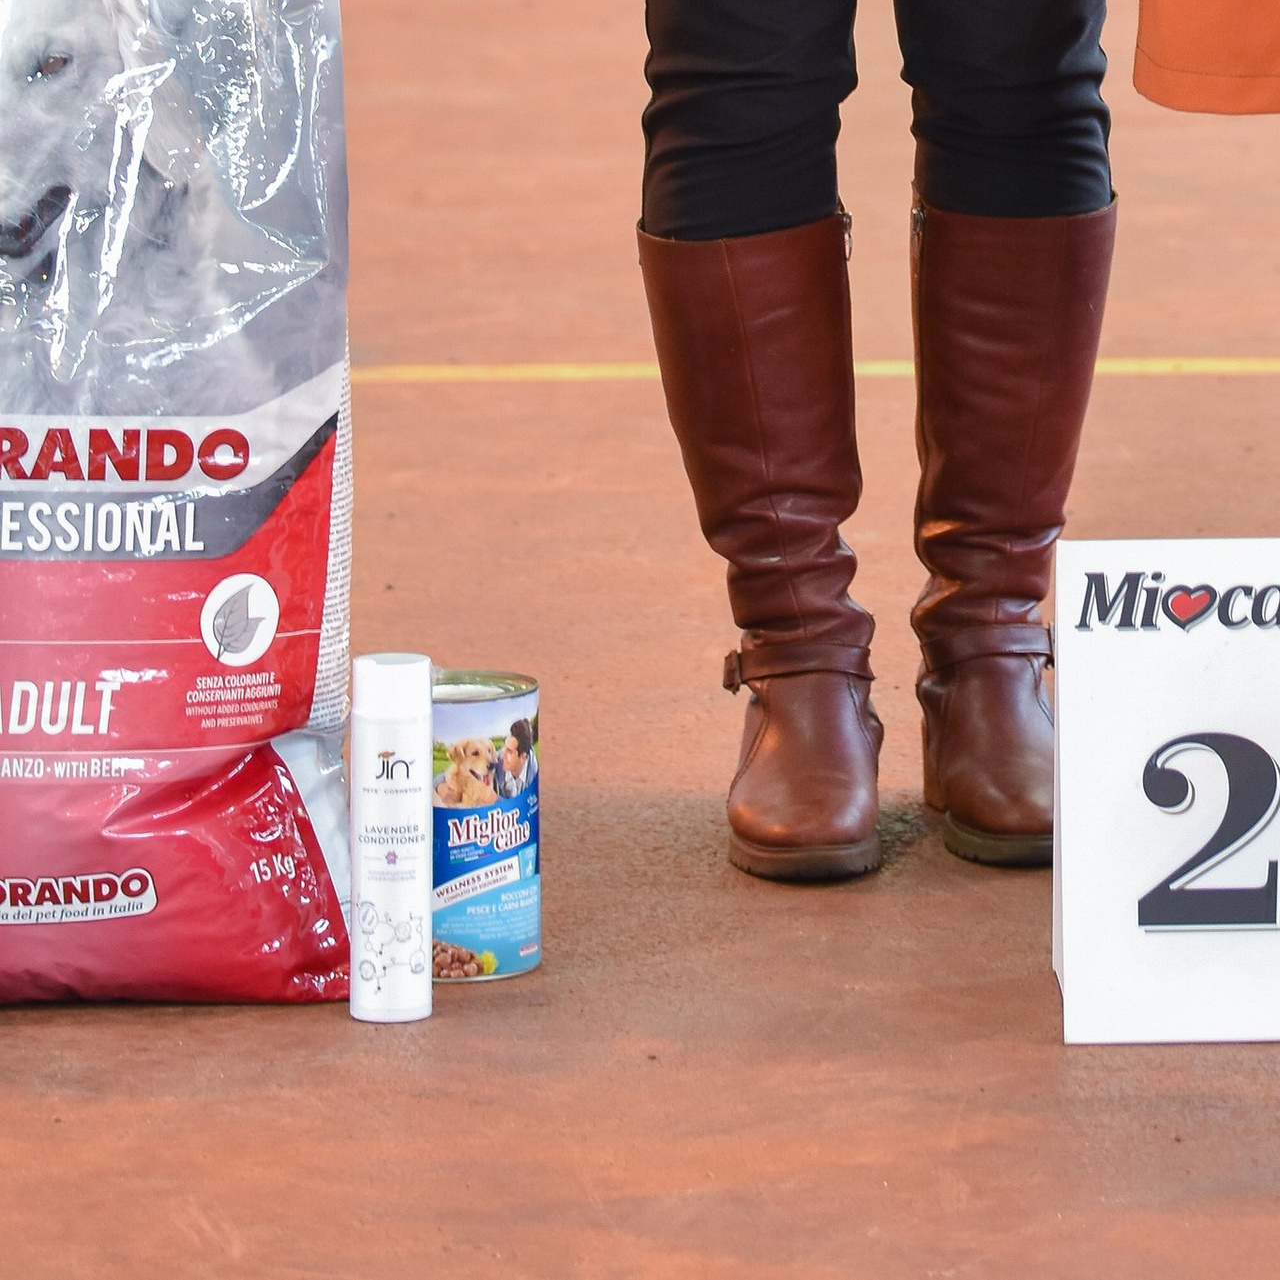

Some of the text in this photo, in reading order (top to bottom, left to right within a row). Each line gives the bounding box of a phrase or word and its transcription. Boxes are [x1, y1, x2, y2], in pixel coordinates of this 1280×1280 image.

[196, 671, 276, 690] SENZA COLORANTI E
[186, 684, 282, 703] CONSERVANTI AGGIUNTI
[0, 681, 121, 734] DULT
[185, 705, 217, 717] WITHOUT
[217, 703, 240, 715] ADDED
[201, 714, 264, 729] AND PRESERVATIVES
[54, 761, 88, 778] WITH
[365, 824, 419, 835] LAVENDER
[448, 808, 520, 847] Miglior
[494, 820, 530, 852] cane
[358, 834, 426, 845] CONDITIONER
[250, 852, 296, 884] 15 Kg
[0, 872, 149, 907] RANDO
[436, 875, 482, 898] WELLNESS
[484, 863, 514, 878] SYSTEM
[13, 909, 32, 920] del
[36, 909, 56, 922] pet
[60, 907, 89, 921] food
[93, 906, 105, 916] in
[109, 901, 143, 915] Italia
